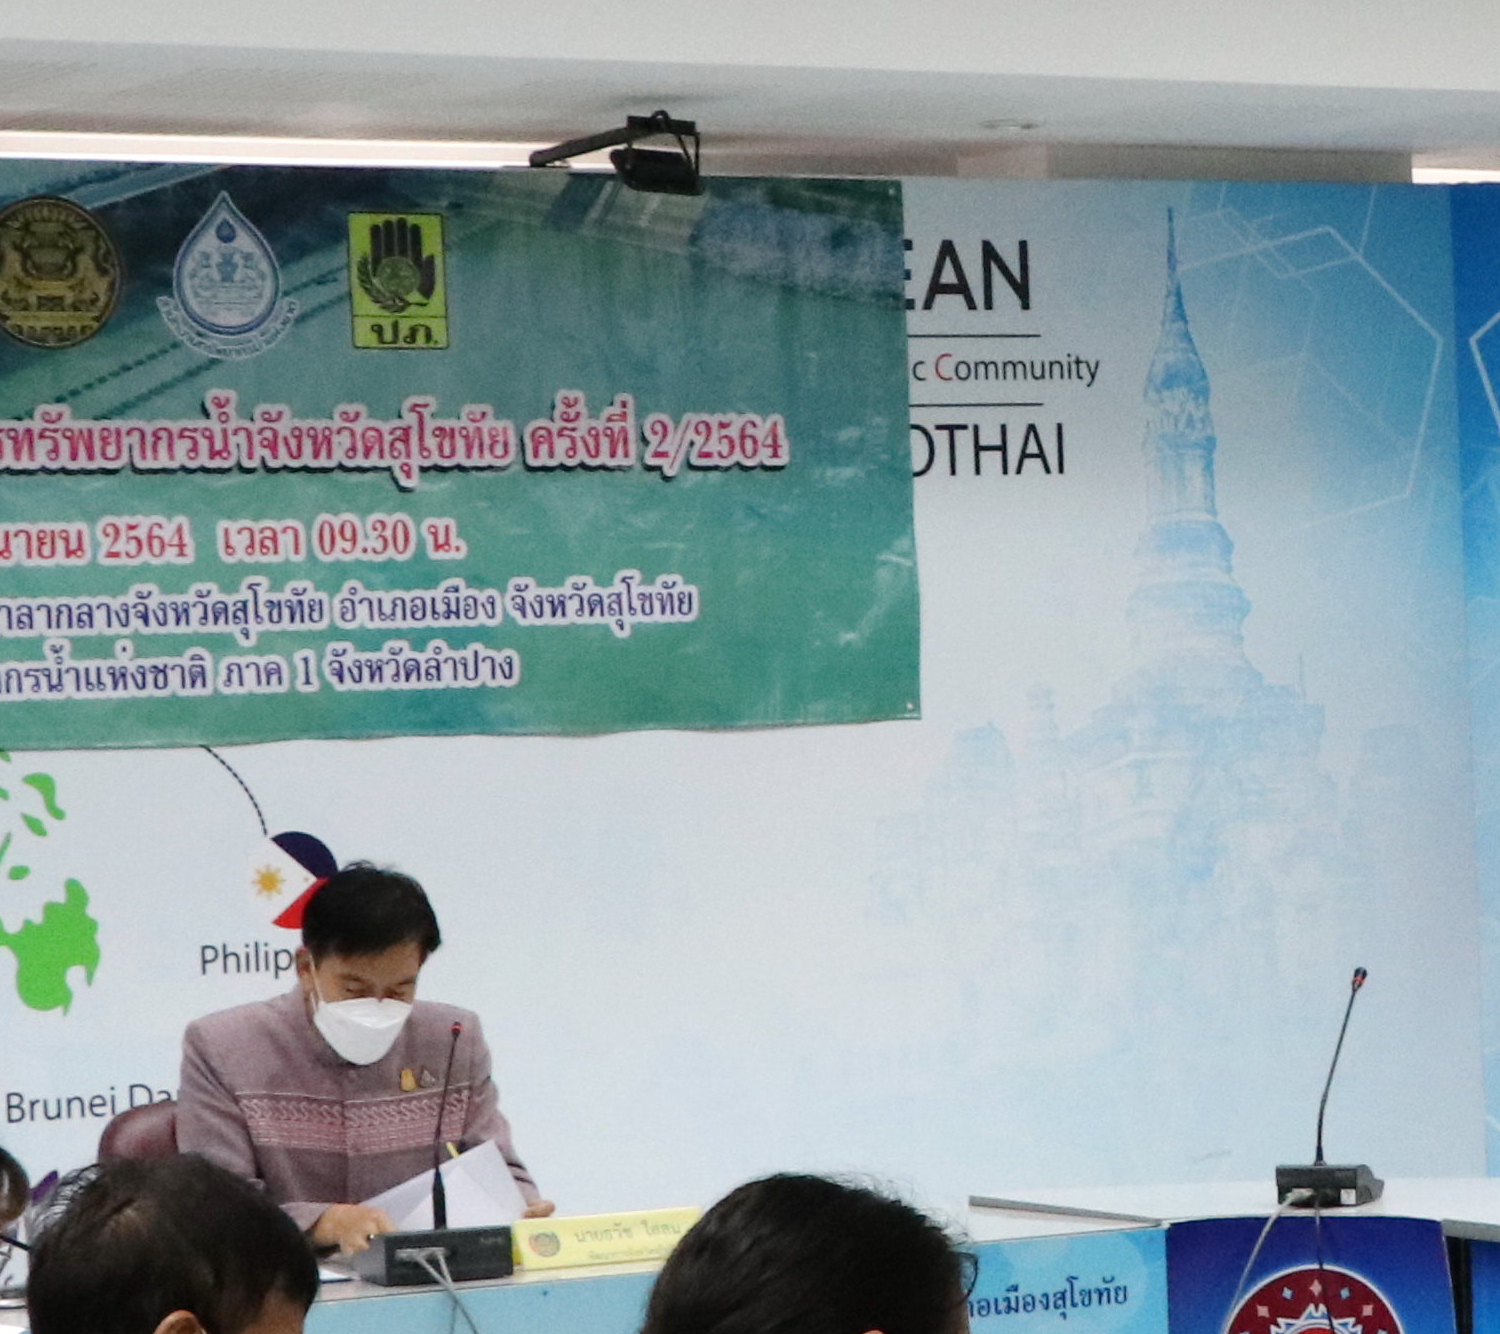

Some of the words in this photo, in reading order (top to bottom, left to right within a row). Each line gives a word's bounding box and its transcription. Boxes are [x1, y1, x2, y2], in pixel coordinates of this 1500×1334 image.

[934, 353, 1100, 387] Community
[528, 395, 632, 461] ครั้งที่
[648, 415, 786, 467] 2/2564
[100, 521, 190, 559] 2564
[221, 523, 300, 559] เวลา
[316, 519, 412, 557] 09.30
[425, 521, 464, 555] น.
[340, 591, 496, 621] อำเภอเมือง
[510, 577, 696, 633] จังหวัดสุโขทัย
[222, 661, 286, 687] ภาค
[302, 657, 314, 687] 1
[328, 649, 515, 685] จังหวัดลำปาง
[6, 1085, 116, 1124] Brunei
